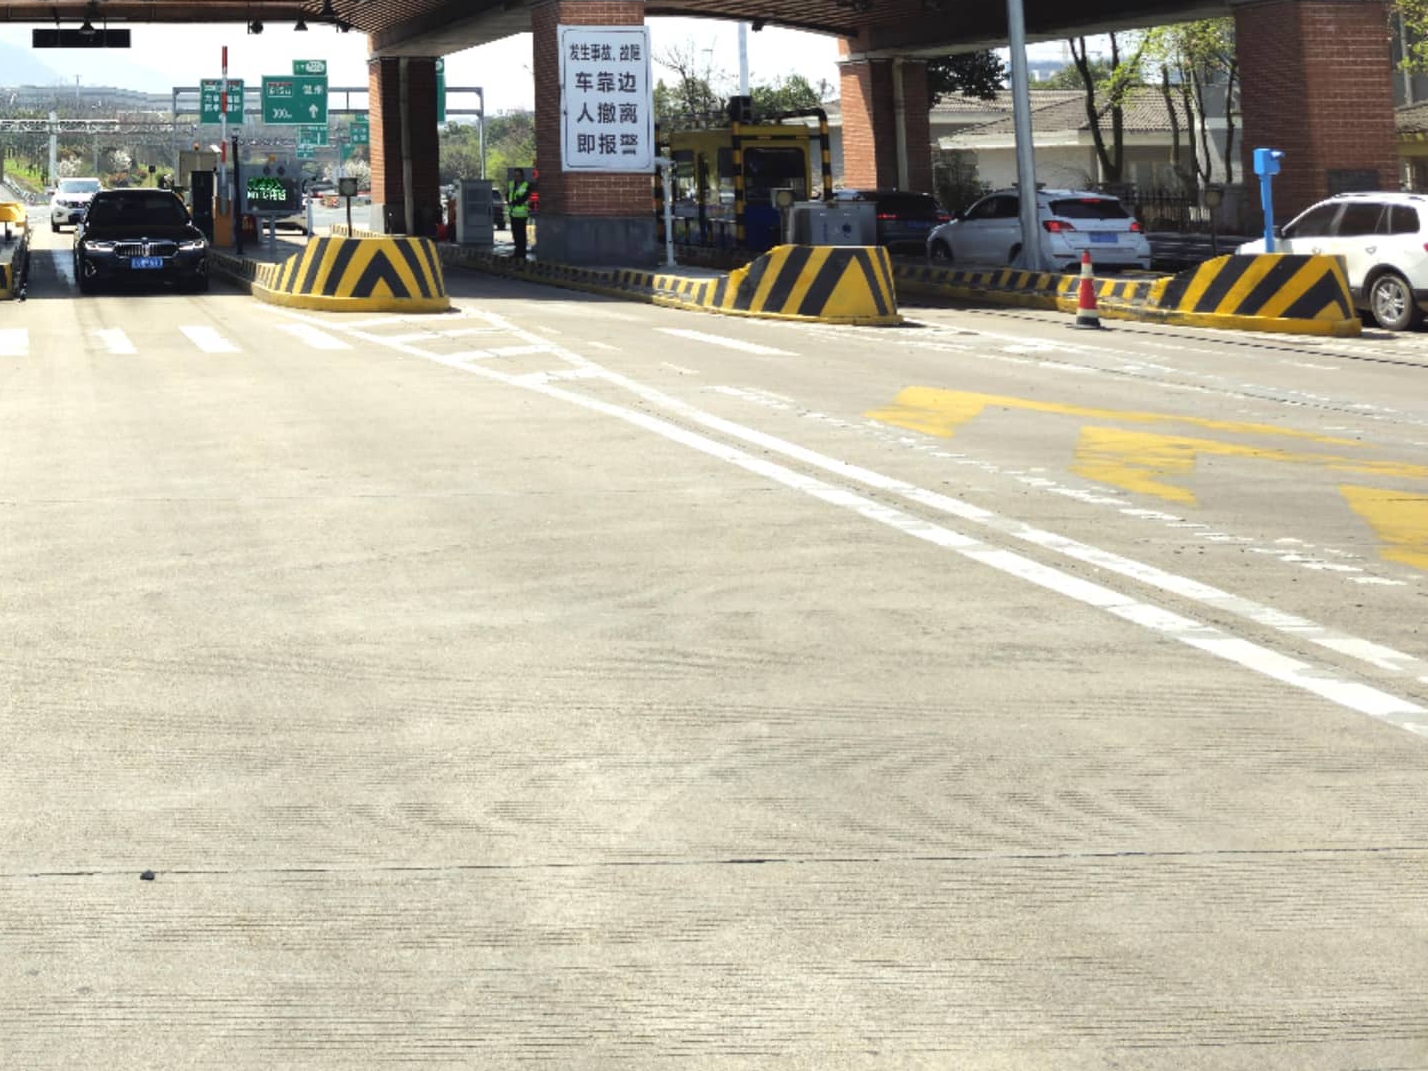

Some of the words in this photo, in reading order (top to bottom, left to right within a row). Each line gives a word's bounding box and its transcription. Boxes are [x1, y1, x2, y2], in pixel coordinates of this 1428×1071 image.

[575, 71, 638, 94] 车靠边
[576, 101, 639, 125] 人撤离
[577, 132, 639, 156] 即报警
